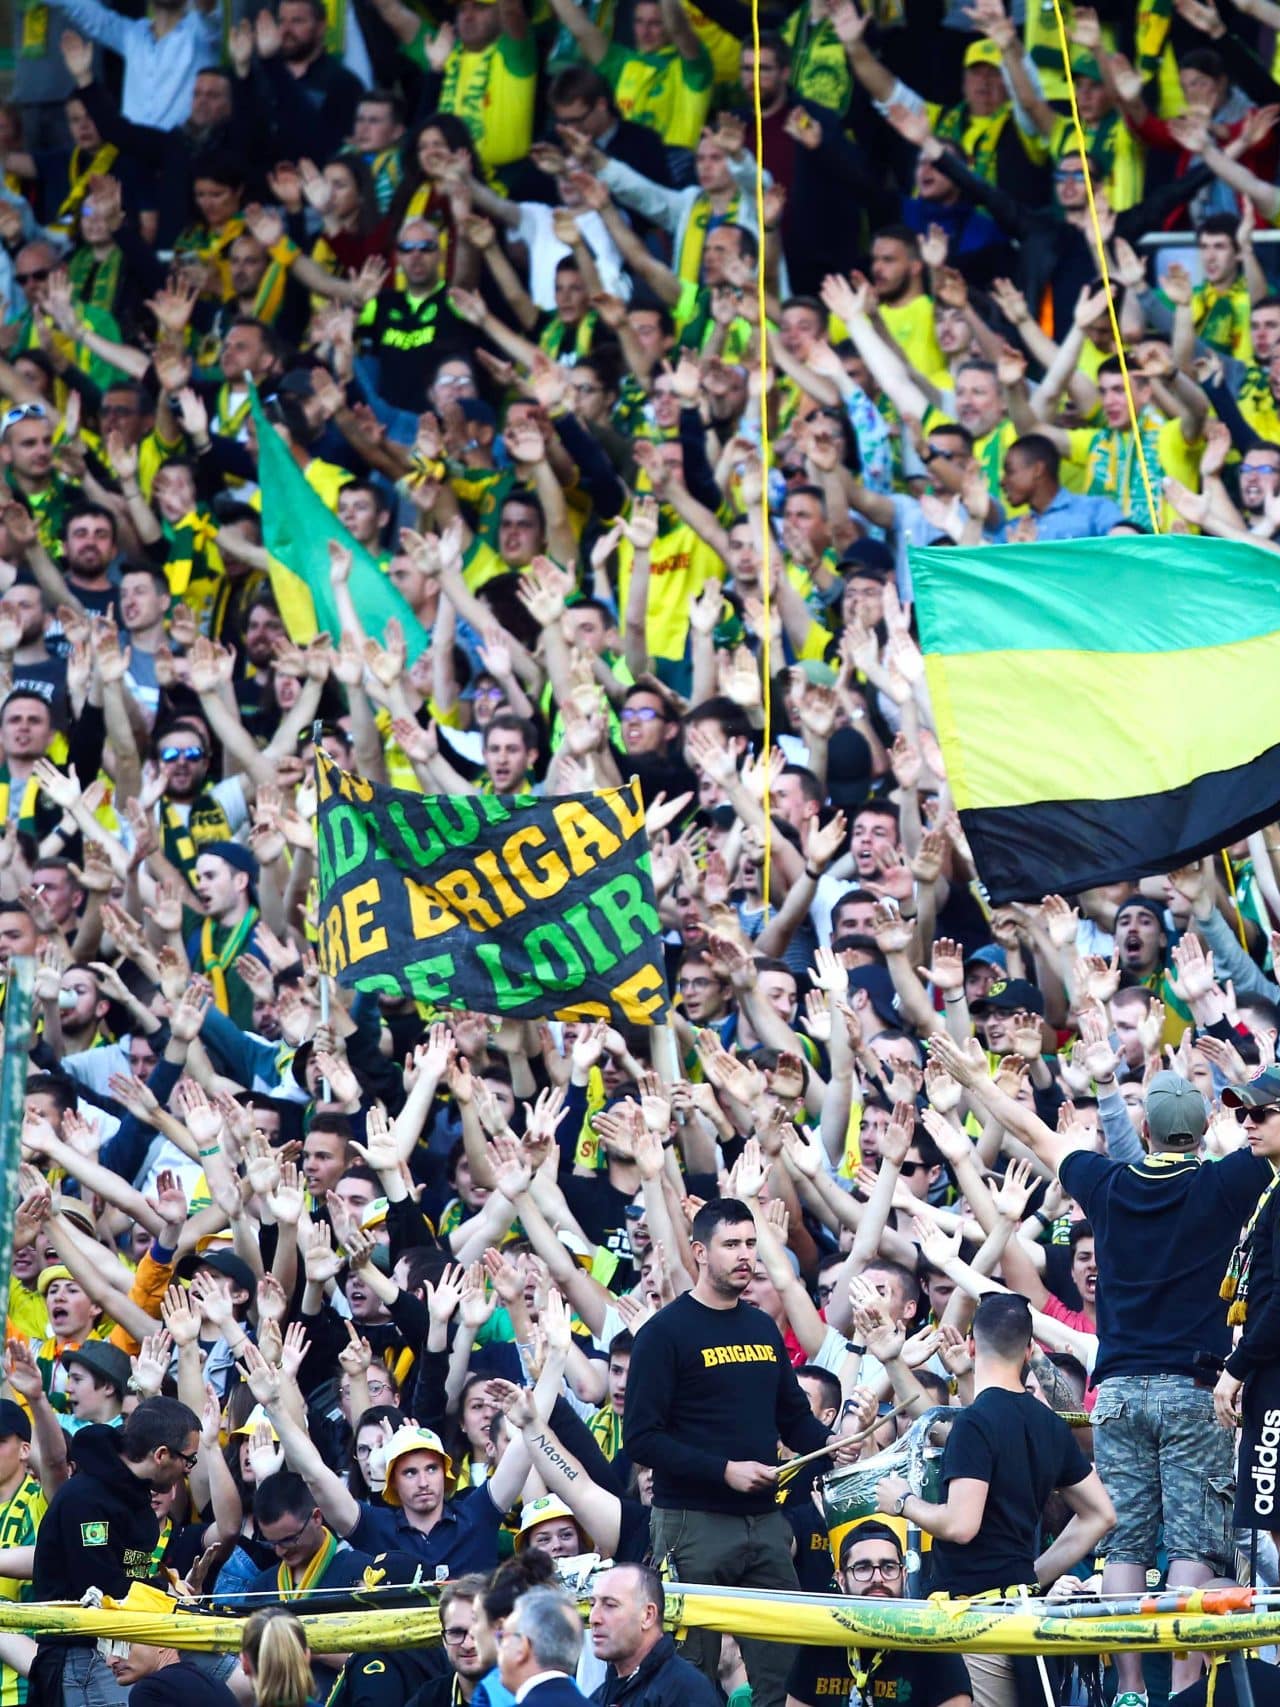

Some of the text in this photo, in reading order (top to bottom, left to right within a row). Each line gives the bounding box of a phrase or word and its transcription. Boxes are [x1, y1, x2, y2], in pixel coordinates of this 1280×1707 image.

[476, 852, 663, 1011] LOIR
[701, 1344, 777, 1367] BRIGADE
[531, 1434, 579, 1481] Naoned
[815, 1676, 897, 1699] BRIDE
